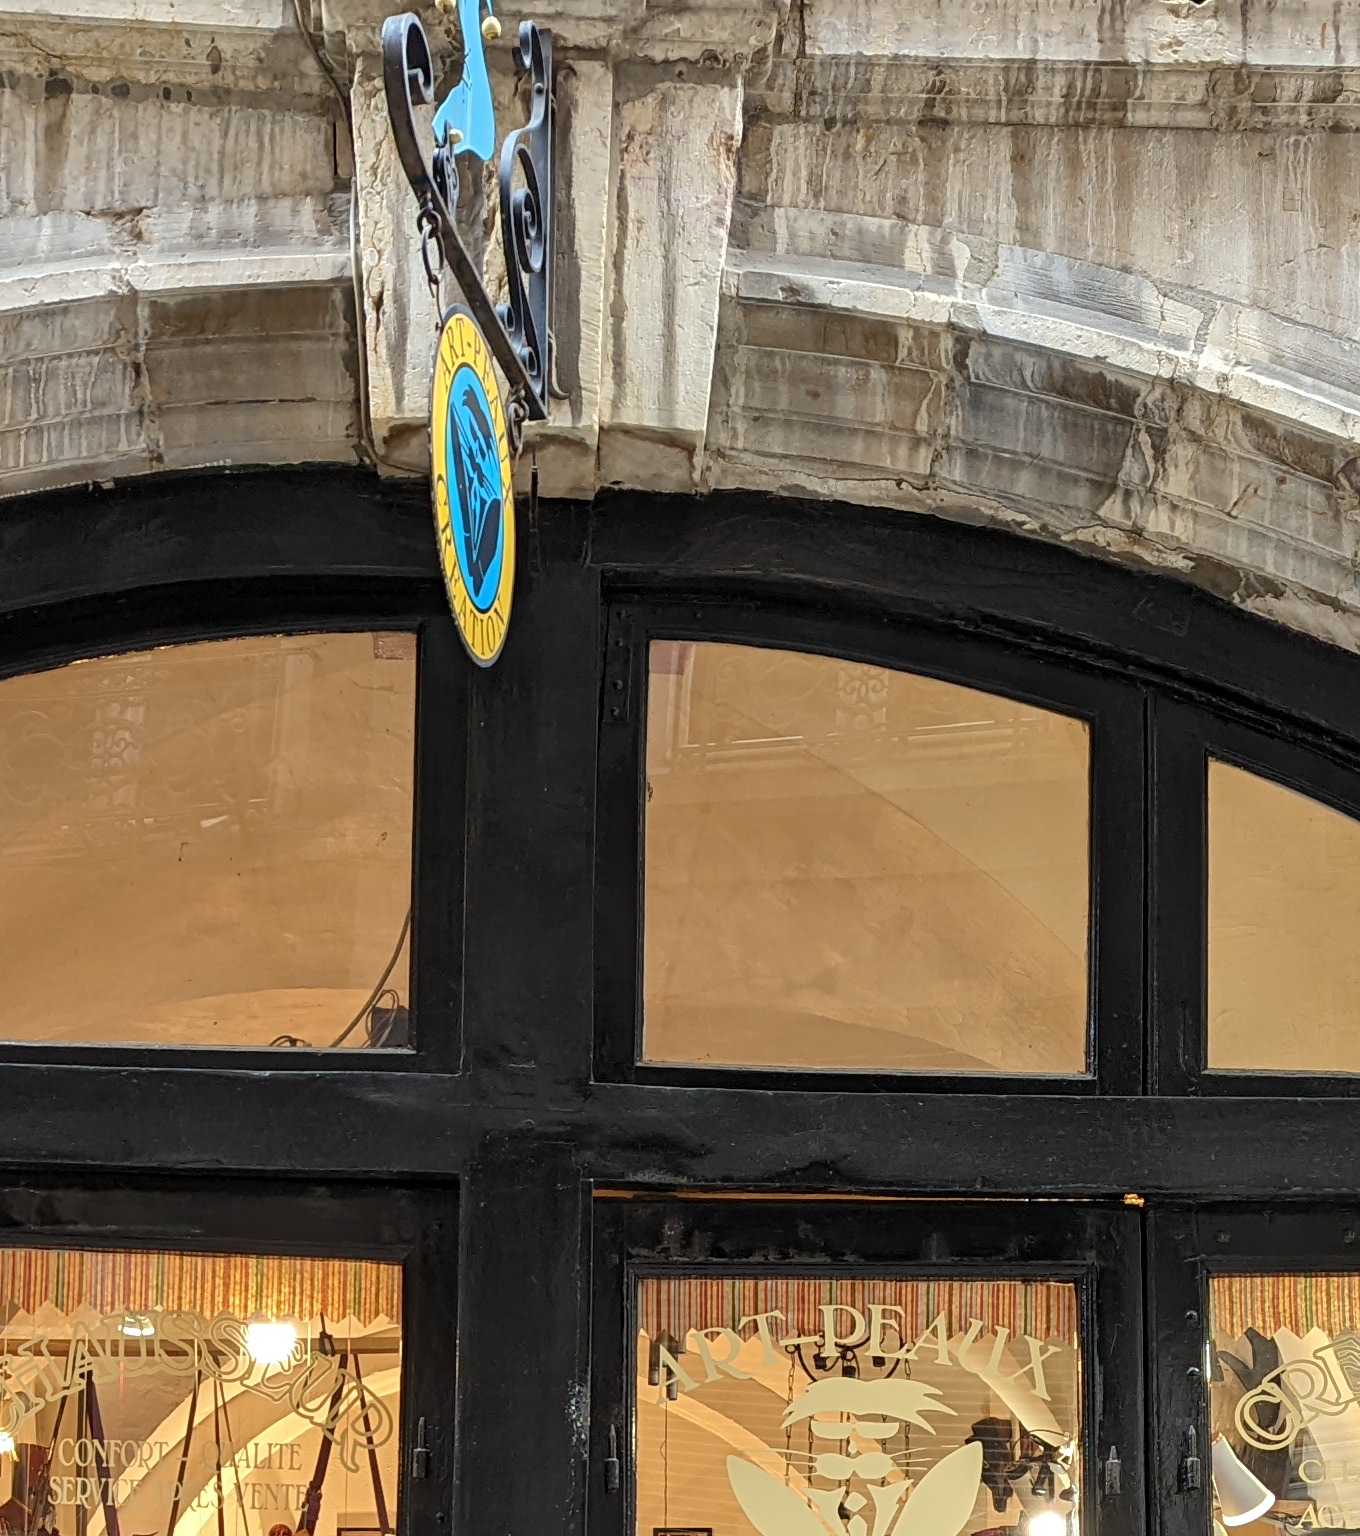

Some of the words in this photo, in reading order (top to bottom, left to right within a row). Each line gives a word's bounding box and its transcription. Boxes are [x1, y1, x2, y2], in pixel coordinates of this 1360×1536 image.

[656, 1304, 1062, 1406] ART-PEAUX
[58, 1437, 170, 1472] CONFORT
[201, 1440, 302, 1474] QUALITE
[47, 1476, 142, 1509] SERVICE
[233, 1482, 310, 1512] VENTE
